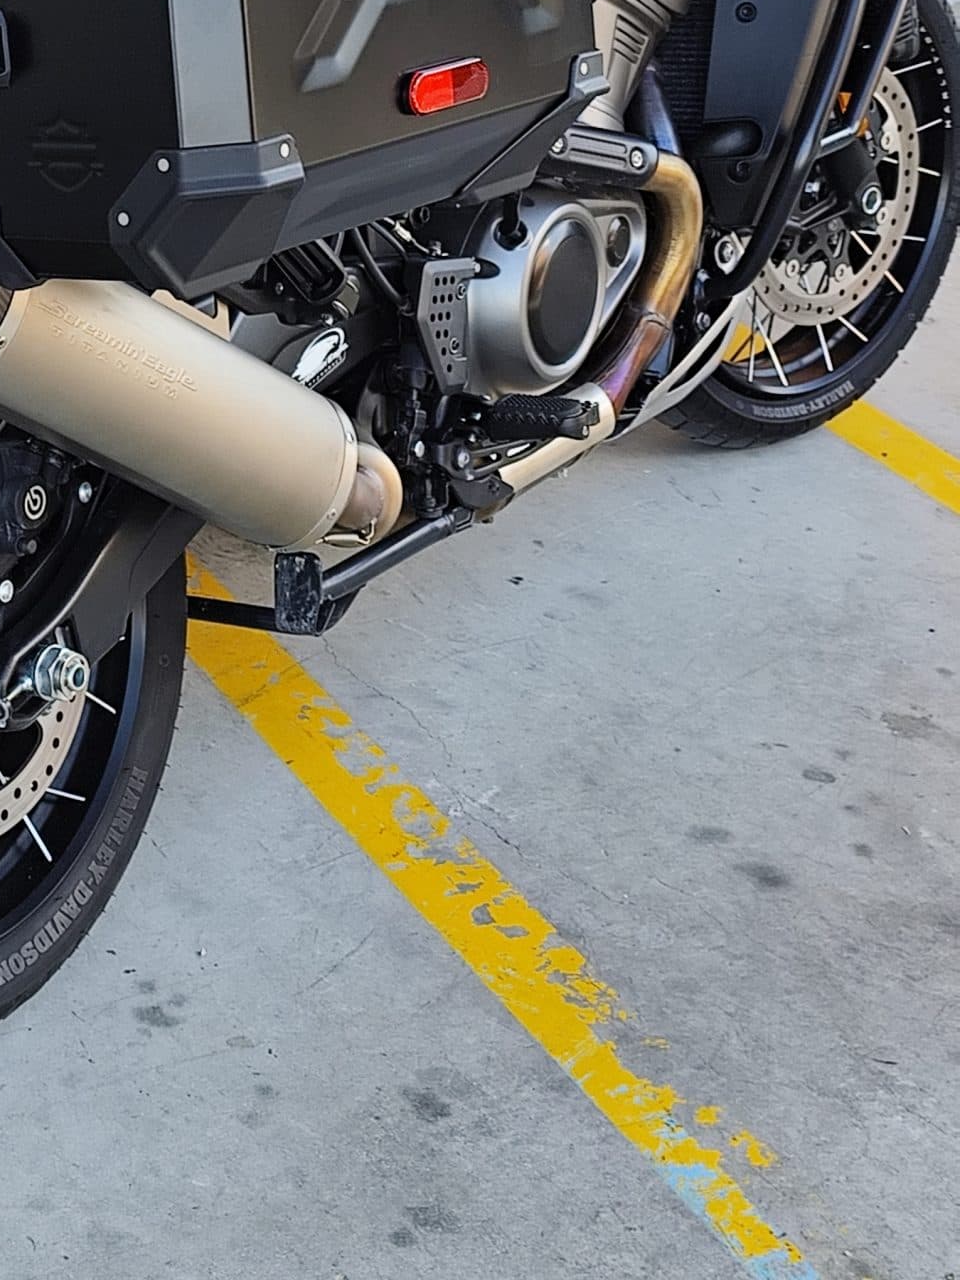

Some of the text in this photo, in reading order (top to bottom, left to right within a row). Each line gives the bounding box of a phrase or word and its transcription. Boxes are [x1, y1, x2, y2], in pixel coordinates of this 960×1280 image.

[50, 324, 179, 401] TITANIUM
[141, 352, 198, 393] Eagle
[751, 379, 856, 419] HARLEY-DAVIDSON
